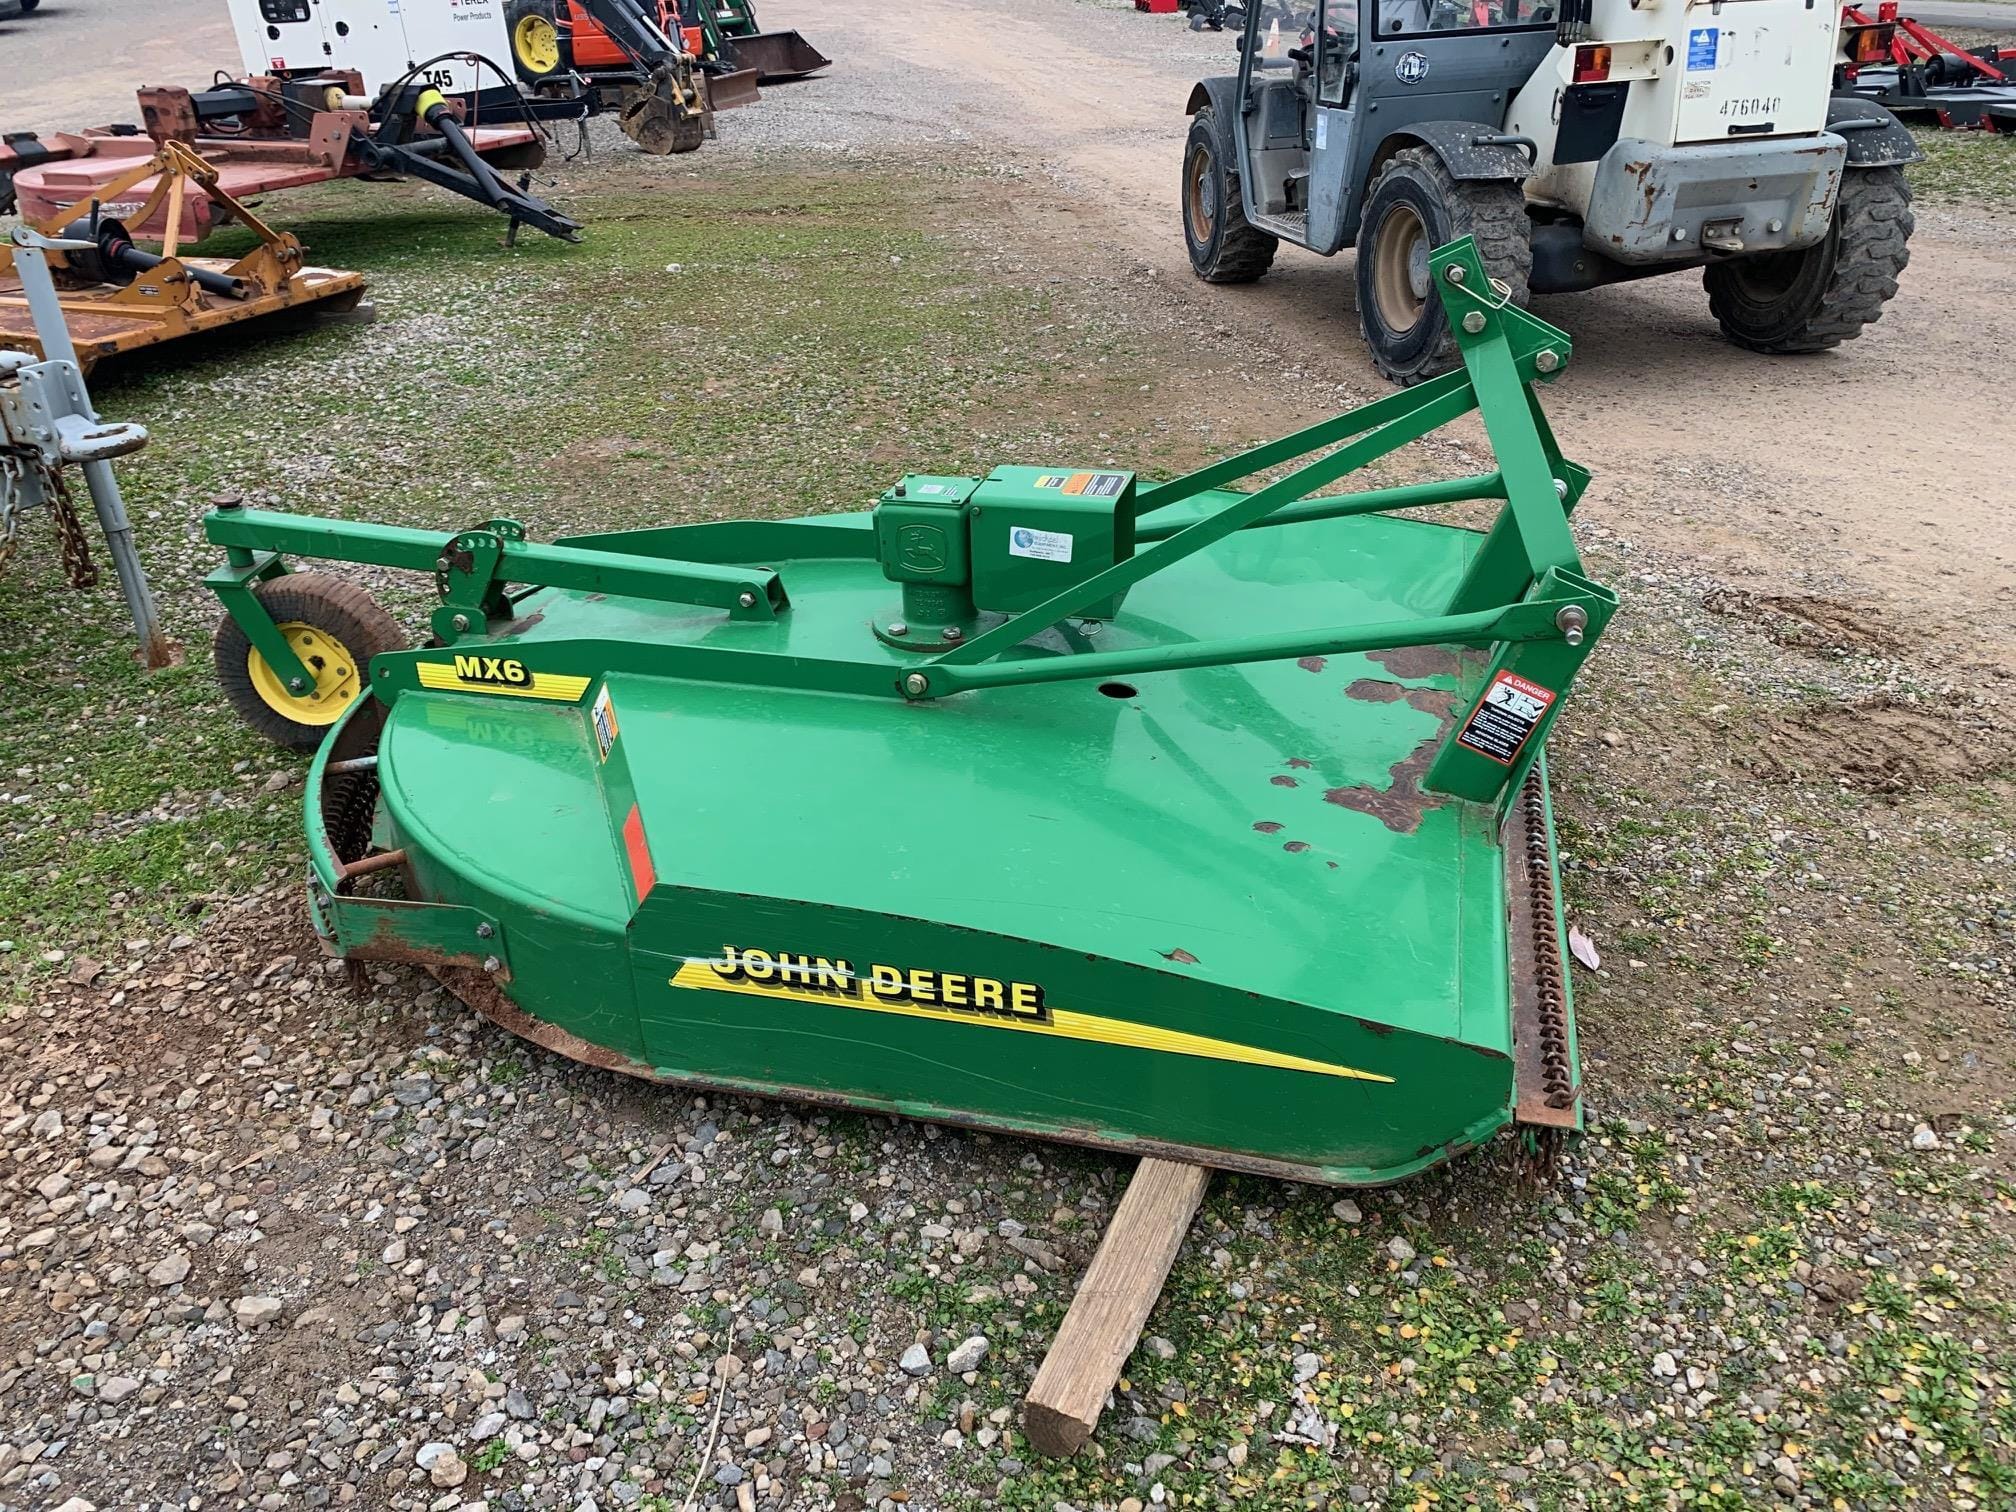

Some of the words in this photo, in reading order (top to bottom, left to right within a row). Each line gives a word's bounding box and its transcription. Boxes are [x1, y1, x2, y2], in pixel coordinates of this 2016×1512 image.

[453, 12, 469, 22] Power
[470, 11, 492, 20] Products
[423, 70, 453, 87] T45
[1720, 97, 1781, 117] 476040
[454, 655, 526, 684] MX6
[1514, 679, 1550, 700] DANGER
[711, 945, 849, 989] JOHN
[870, 964, 1038, 1014] DEERE
